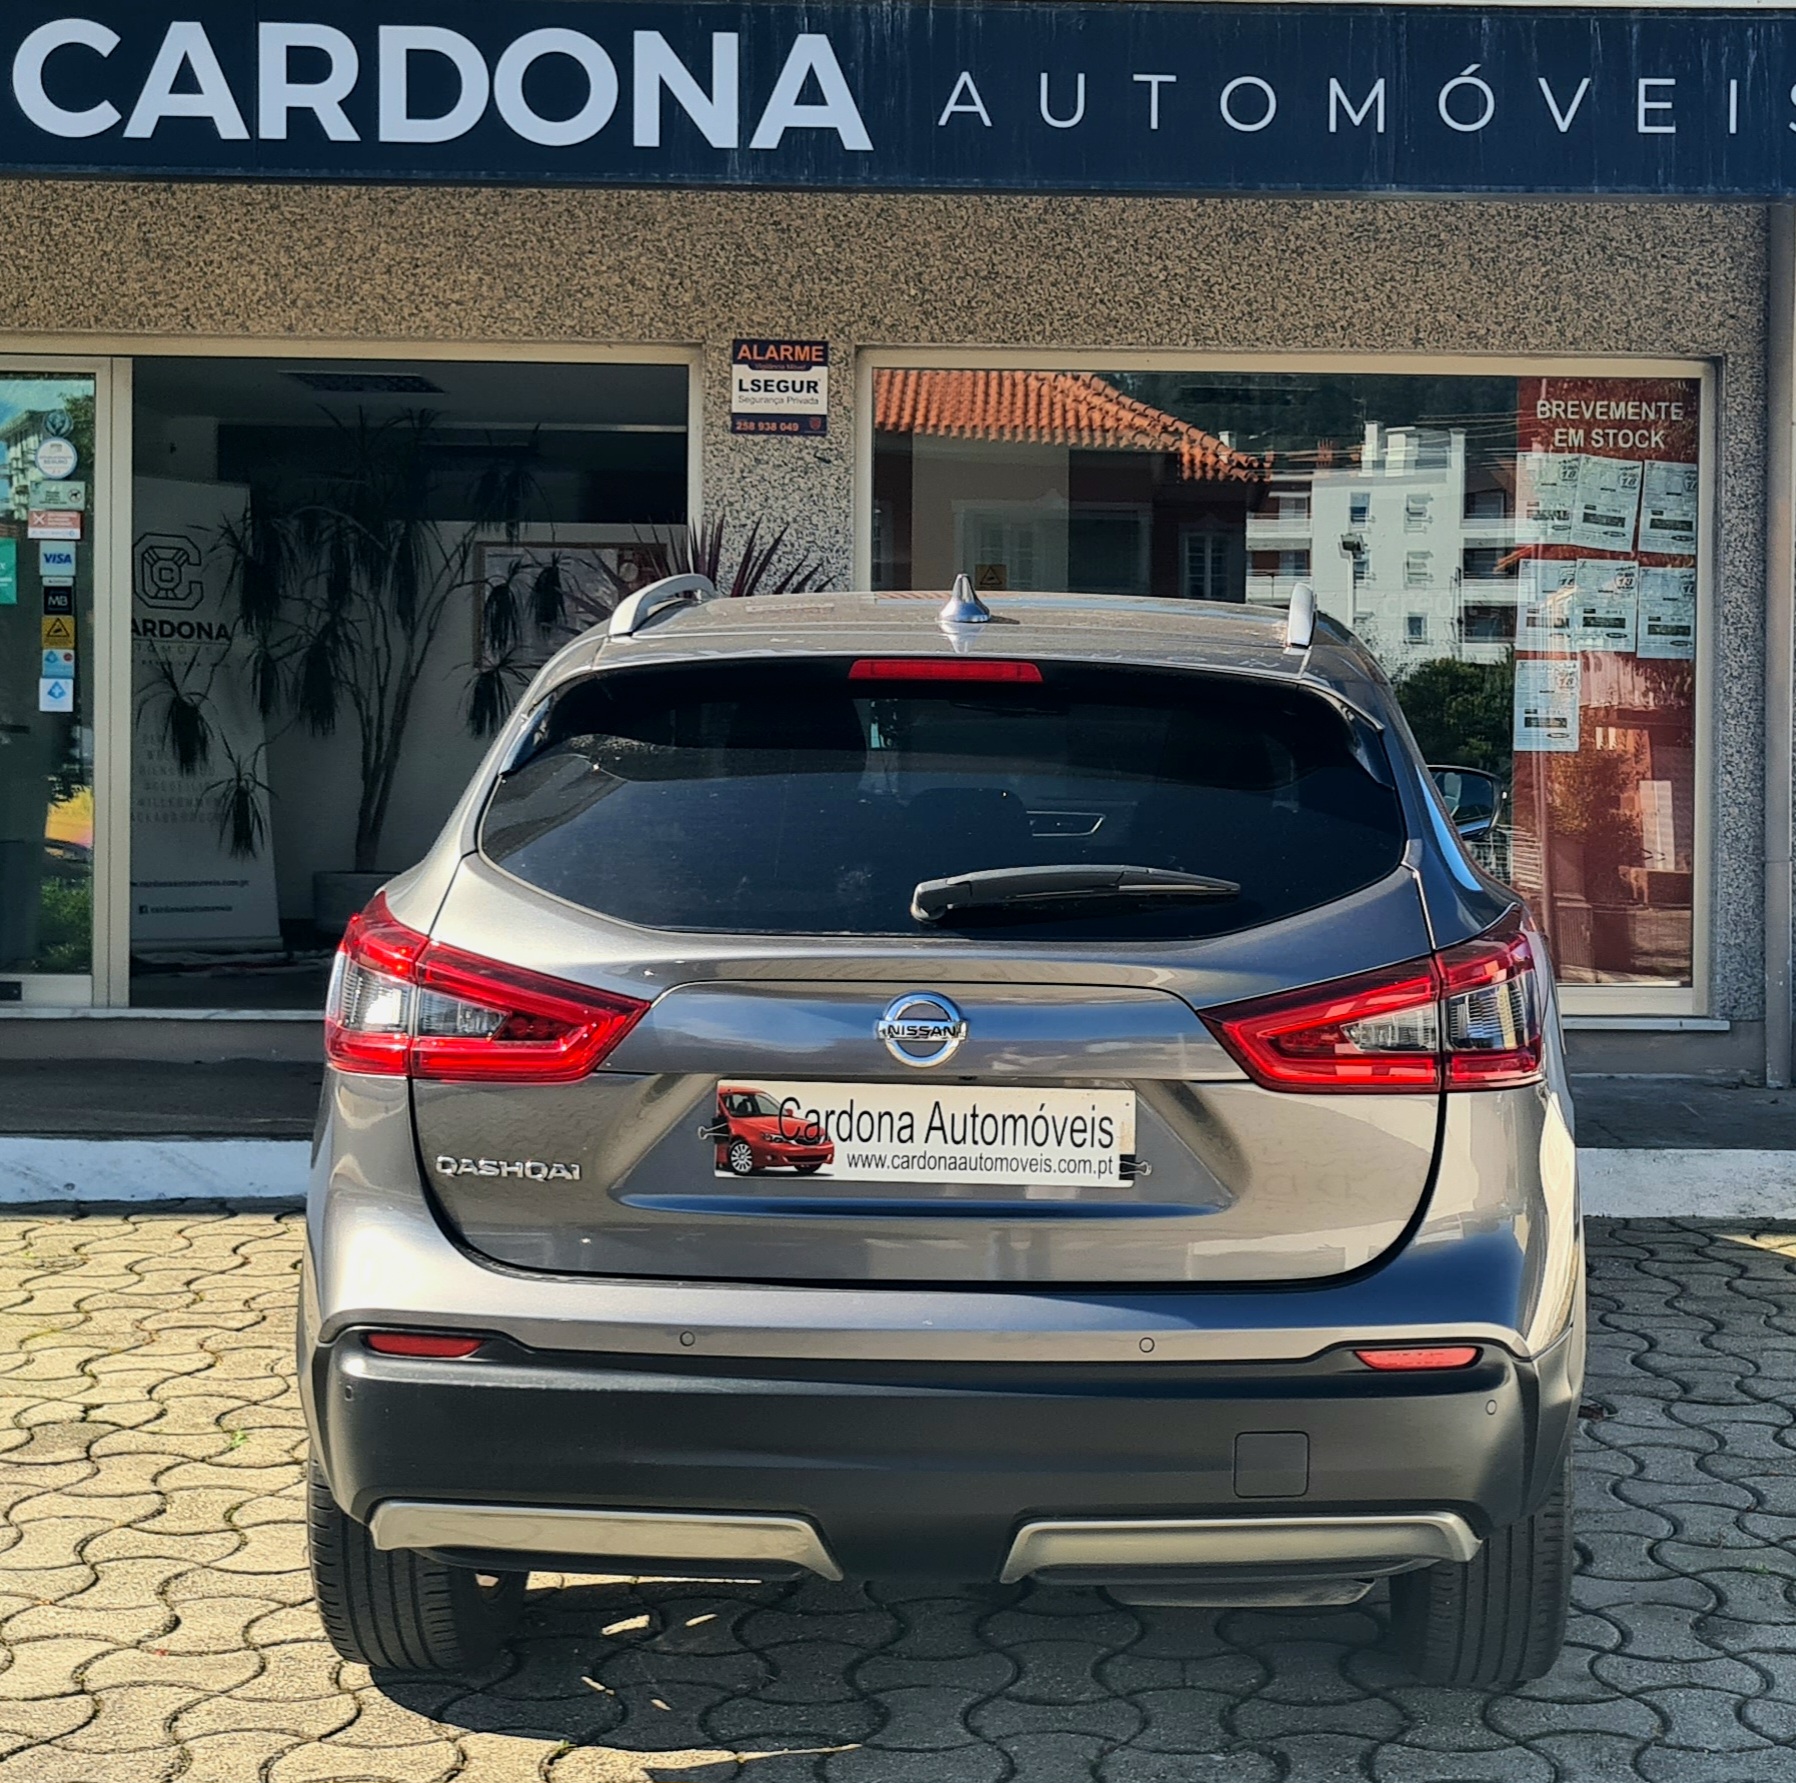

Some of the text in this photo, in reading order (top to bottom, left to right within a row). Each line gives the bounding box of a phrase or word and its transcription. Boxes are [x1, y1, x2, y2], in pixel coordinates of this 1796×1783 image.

[12, 18, 1796, 151] CARDONA AUTOMÓVEI
[737, 344, 824, 361] ALARME
[738, 379, 819, 393] LSEGUR
[738, 395, 819, 405] Segurança Privada
[1536, 400, 1683, 421] BREVEMENTE
[1554, 428, 1665, 448] EM STOCK
[43, 553, 72, 564] VISA
[48, 595, 68, 607] MB
[131, 618, 231, 641] ARDONA
[887, 1024, 957, 1037] NISSAN
[779, 1097, 1114, 1148] Cardona Automóveis
[435, 1155, 582, 1182] QASHQAI
[847, 1149, 1114, 1180] www.cardonaautomoveis.com.pt
